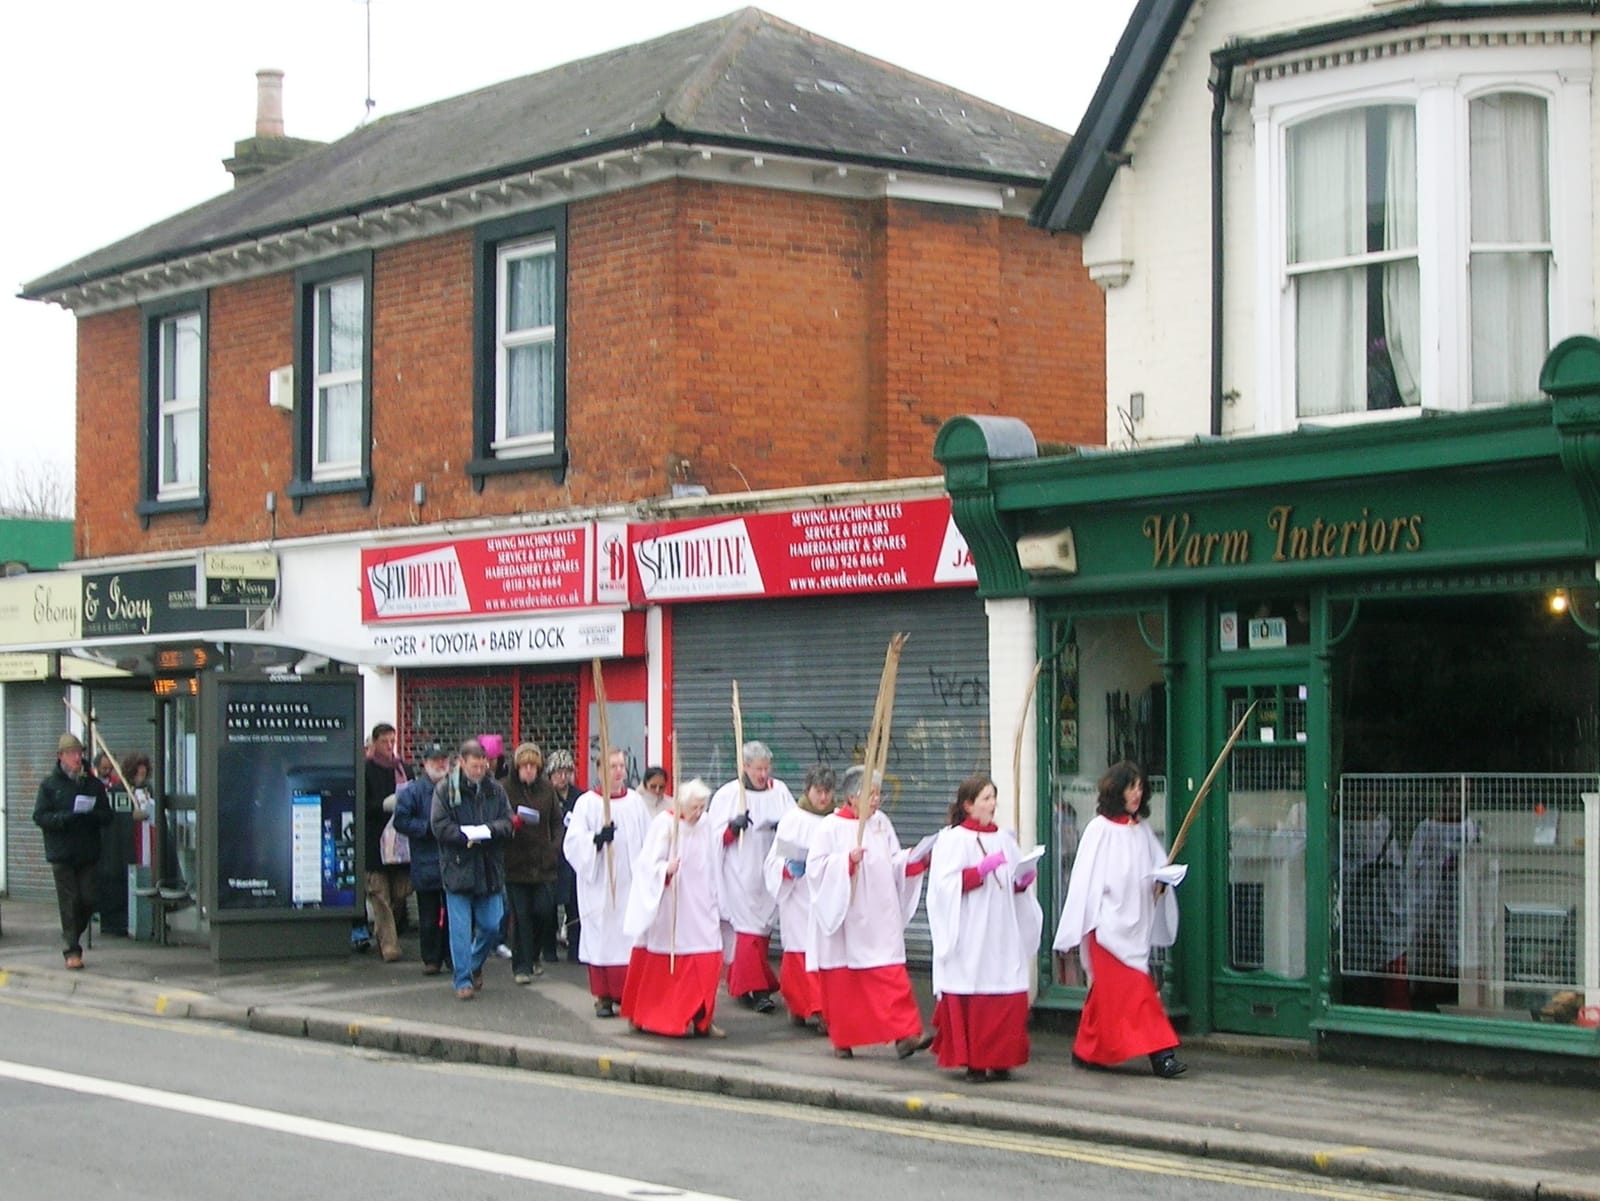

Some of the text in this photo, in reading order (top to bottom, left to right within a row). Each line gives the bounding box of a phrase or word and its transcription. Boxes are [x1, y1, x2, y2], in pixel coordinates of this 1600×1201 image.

[792, 502, 902, 527] SEWING MACHINE SALES
[487, 530, 577, 553] SEWING MACHINE SALES
[805, 520, 889, 541] SERVICE & REPAIRS
[1143, 505, 1422, 568] Warm Interiors
[497, 545, 566, 565] SERVICE & REPAIRS
[789, 533, 907, 557] HABERDASHERY & SPARES
[485, 559, 580, 579] HABERDASHERY & SPARES
[810, 552, 884, 572] (0118) 926 8664
[789, 567, 908, 591] www.sewdevine.co.uk
[33, 575, 153, 637] Ebony & Ivory
[485, 588, 579, 610] www.sewdevine.co.uk
[429, 631, 479, 655] TOYOTA
[489, 629, 523, 651] BABY
[528, 626, 565, 649] LOCK
